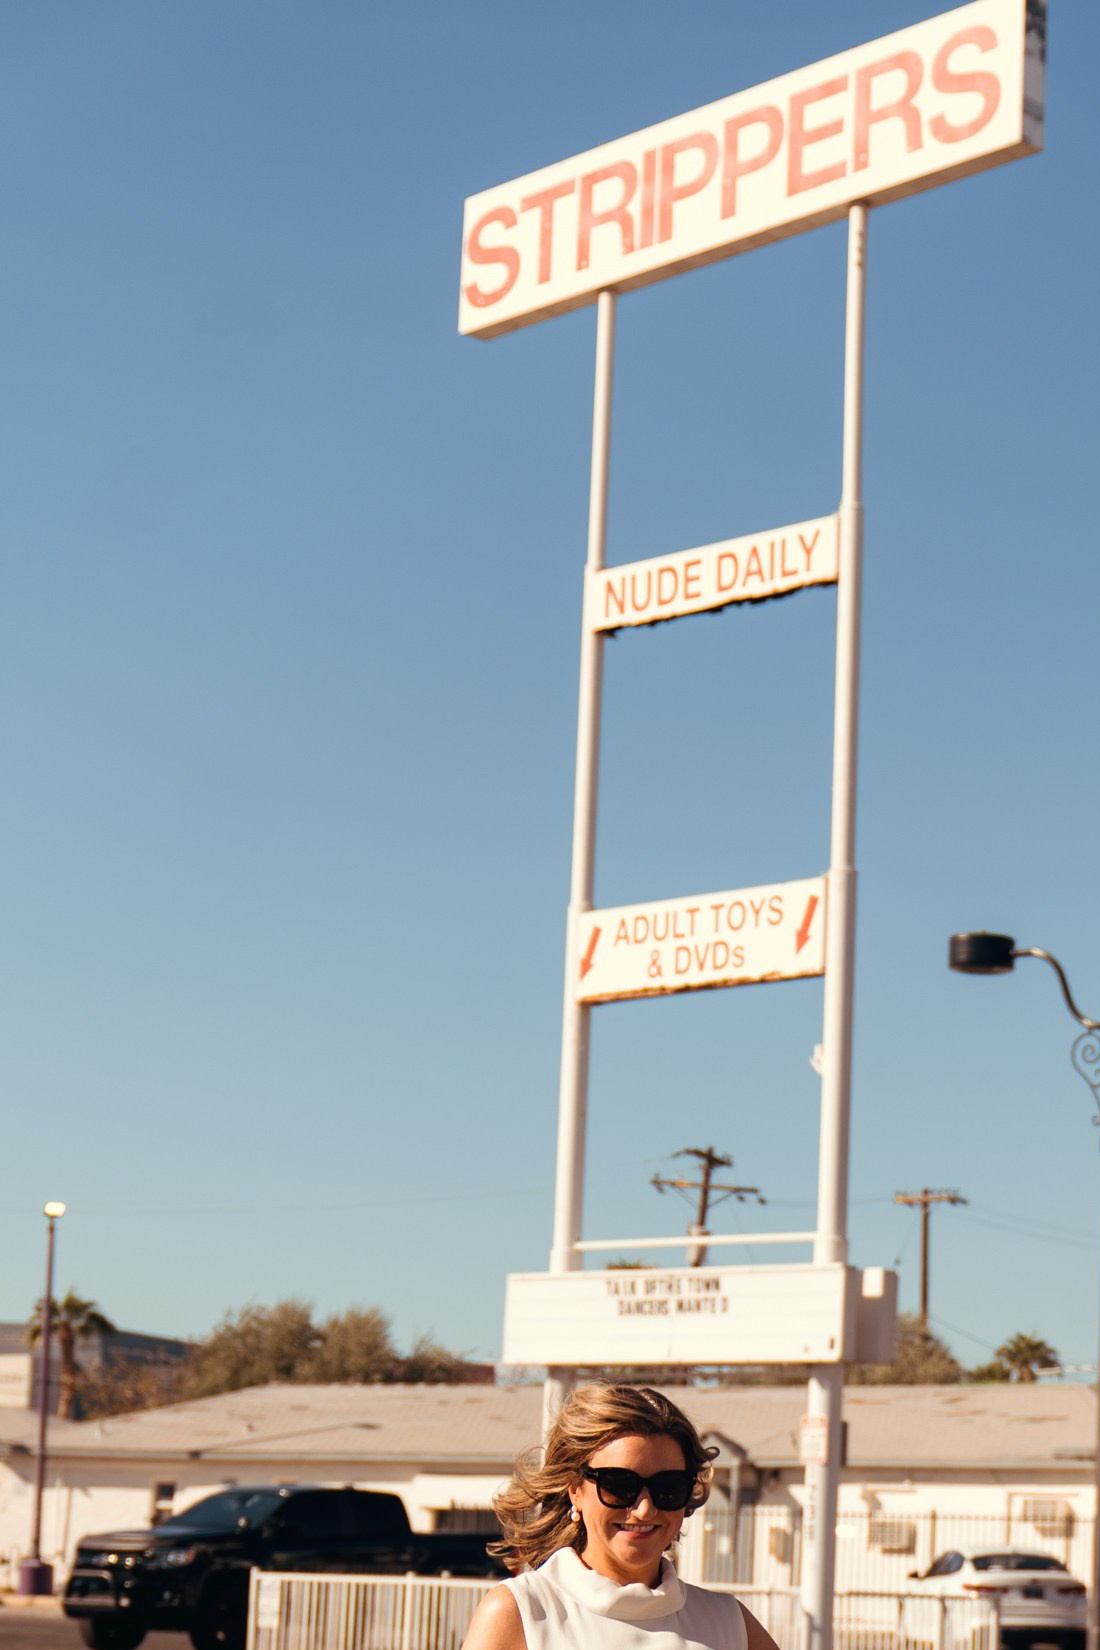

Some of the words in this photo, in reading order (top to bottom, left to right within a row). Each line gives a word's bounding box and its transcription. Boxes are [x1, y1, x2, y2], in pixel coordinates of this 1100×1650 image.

[464, 24, 1002, 309] STRIPPERS
[604, 559, 703, 618] NUDE
[716, 529, 821, 594] DAILY
[613, 907, 700, 947] ADULT
[710, 895, 784, 934] TOYS
[647, 949, 663, 979] &
[674, 941, 746, 976] DVDs
